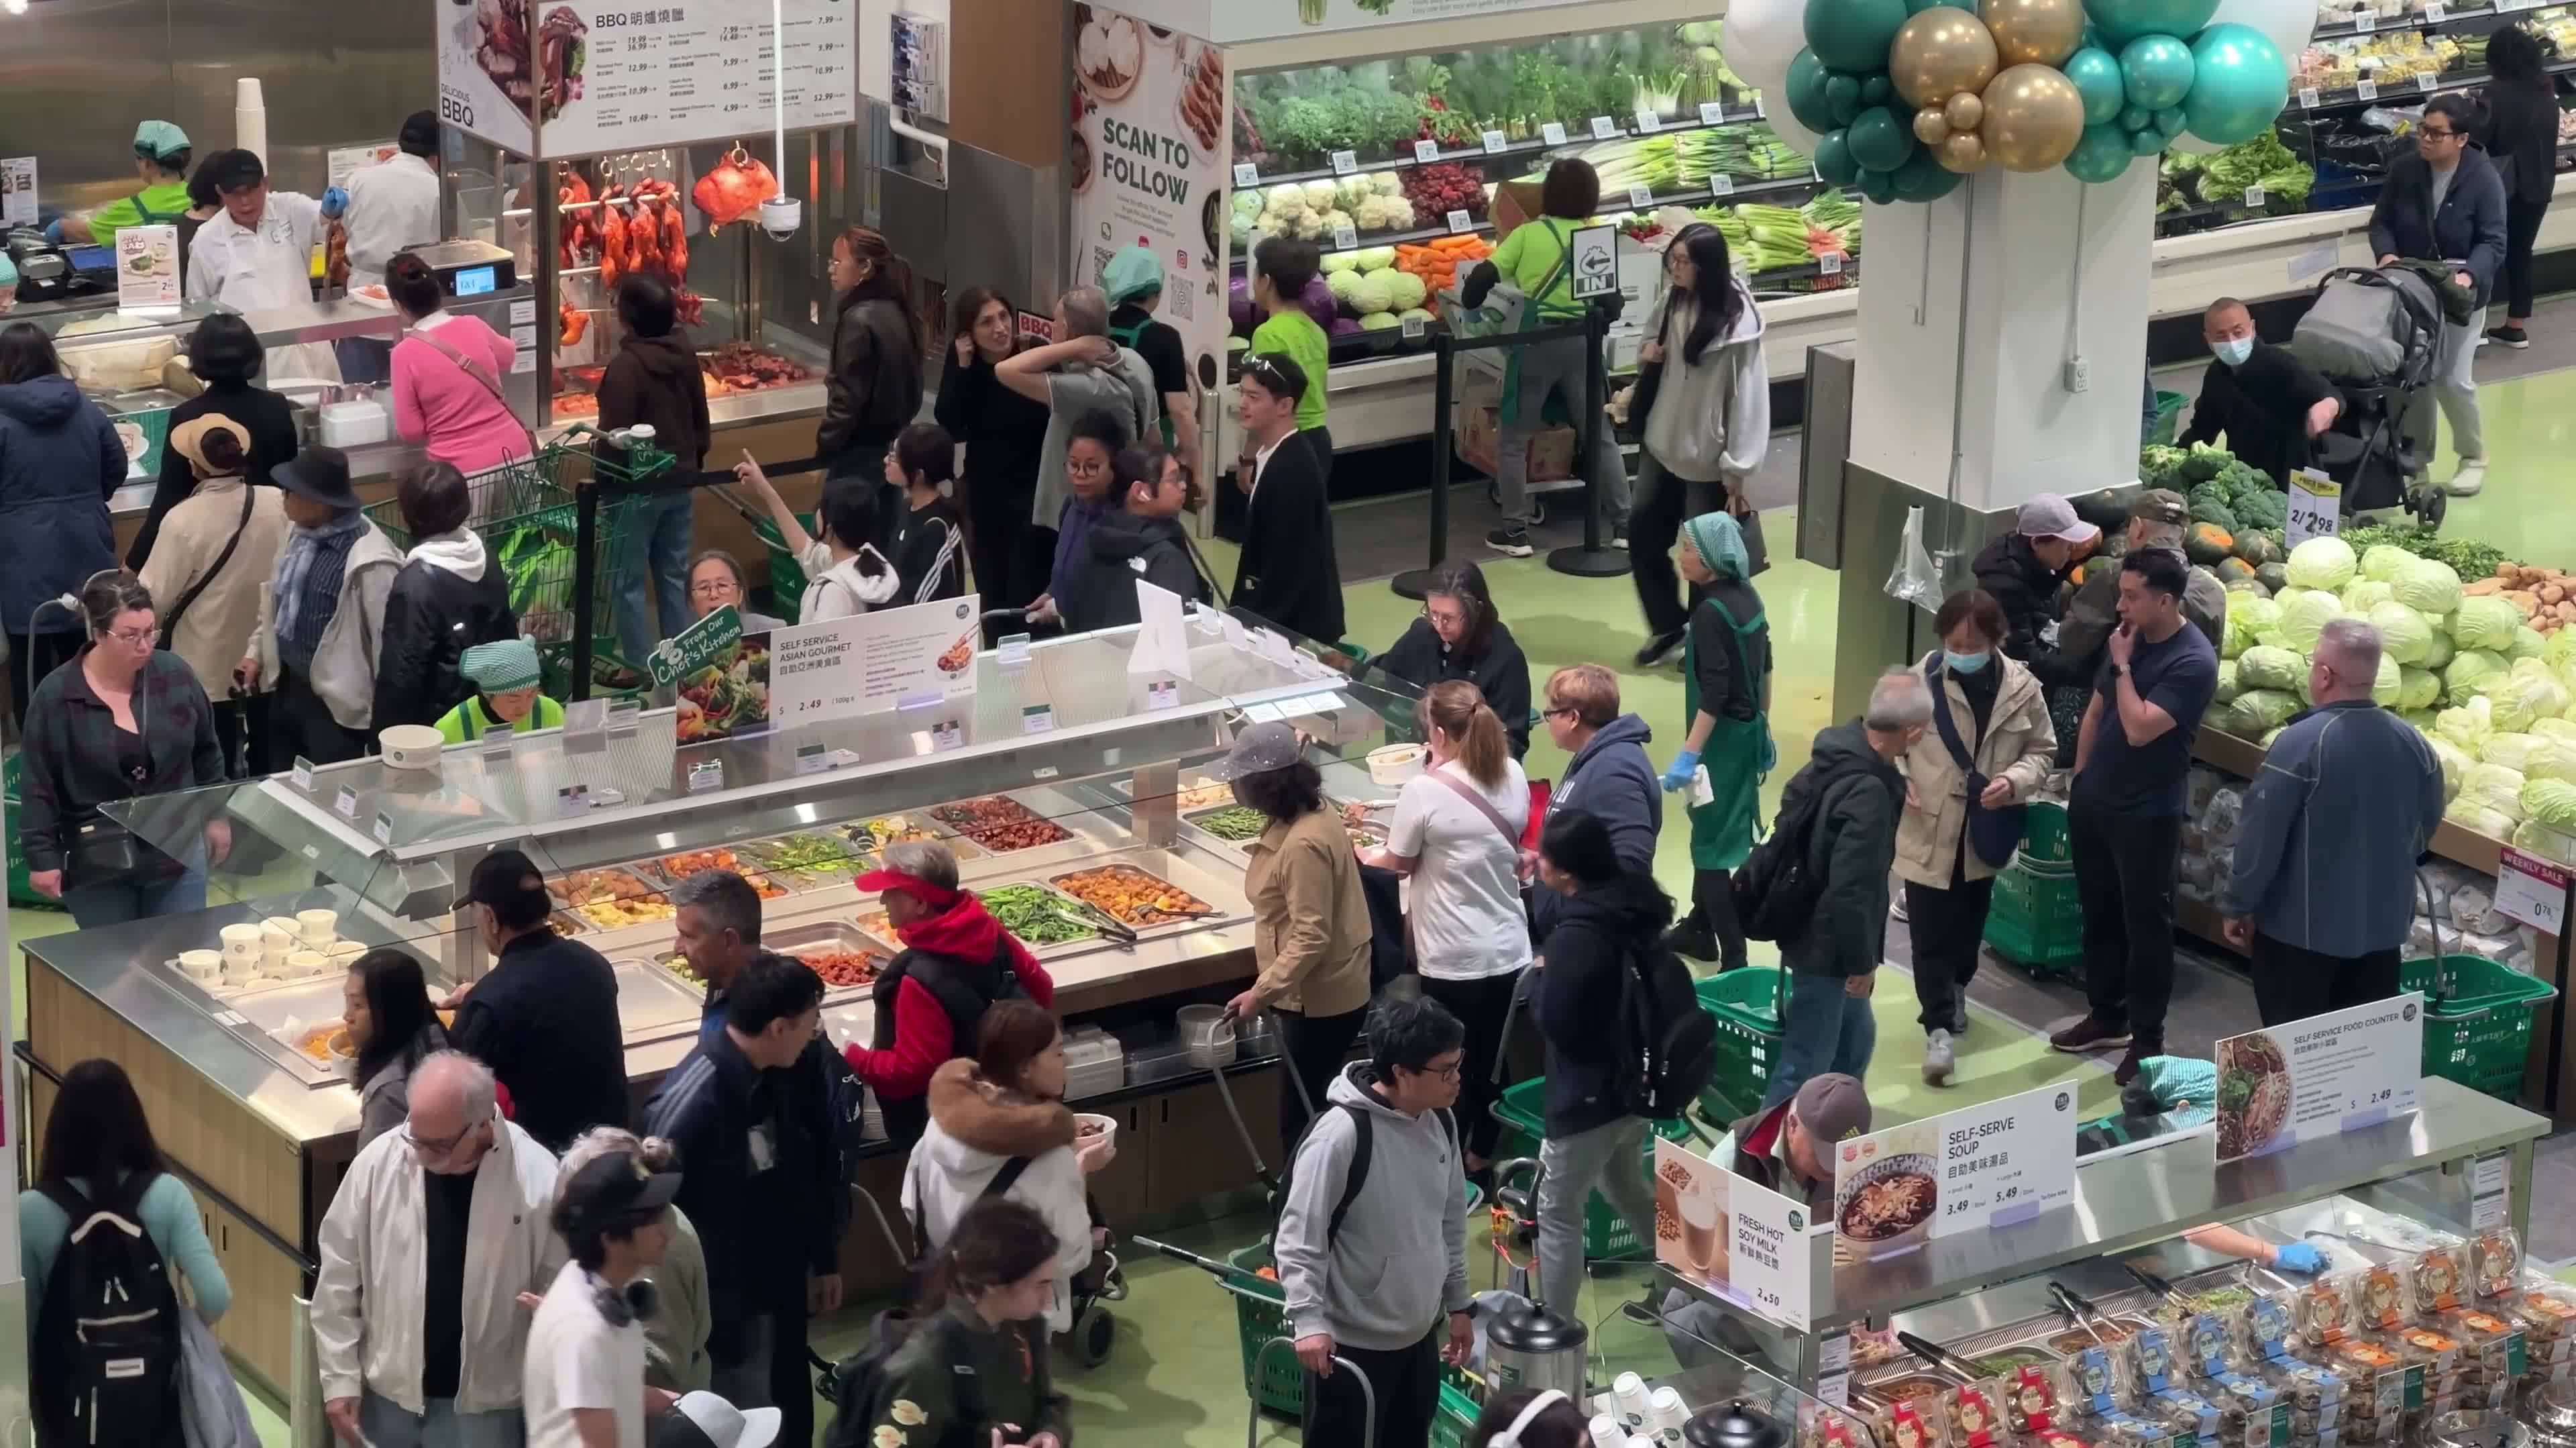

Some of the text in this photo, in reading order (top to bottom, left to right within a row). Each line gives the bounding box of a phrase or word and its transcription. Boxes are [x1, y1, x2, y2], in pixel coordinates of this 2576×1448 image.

[596, 13, 627, 28] BBQ
[818, 16, 833, 24] 7.99
[629, 63, 648, 72] 12.99
[441, 83, 470, 103] DELICIOUS
[441, 96, 474, 129] BBQ
[629, 113, 649, 123] 10.49
[1104, 117, 1189, 169] SCAN TO
[1103, 152, 1189, 205] FOLLOW
[1584, 275, 1607, 291] IN
[1020, 315, 1052, 340] BBQ
[682, 616, 724, 650] From Our
[780, 633, 839, 651] SELF SERVICE
[658, 625, 741, 683] Chef's Kitchen
[780, 642, 852, 662] ASIAN GOURMET
[799, 699, 821, 711] 2.49
[2503, 851, 2563, 884] WEEKLY SALE
[2294, 1013, 2399, 1044] SELF SERVICE FOOD COUNTER
[2371, 1089, 2391, 1103] 2.49
[1949, 1117, 2015, 1145] SELF-SERVE
[1948, 1141, 1979, 1159] SOUP
[1996, 1186, 2017, 1202] 5.49
[1947, 1200, 1968, 1215] 3.49
[1739, 1213, 1784, 1243] FRESH HOT
[1739, 1229, 1777, 1255] SOY MILK
[1757, 1288, 1780, 1306] 2.50
